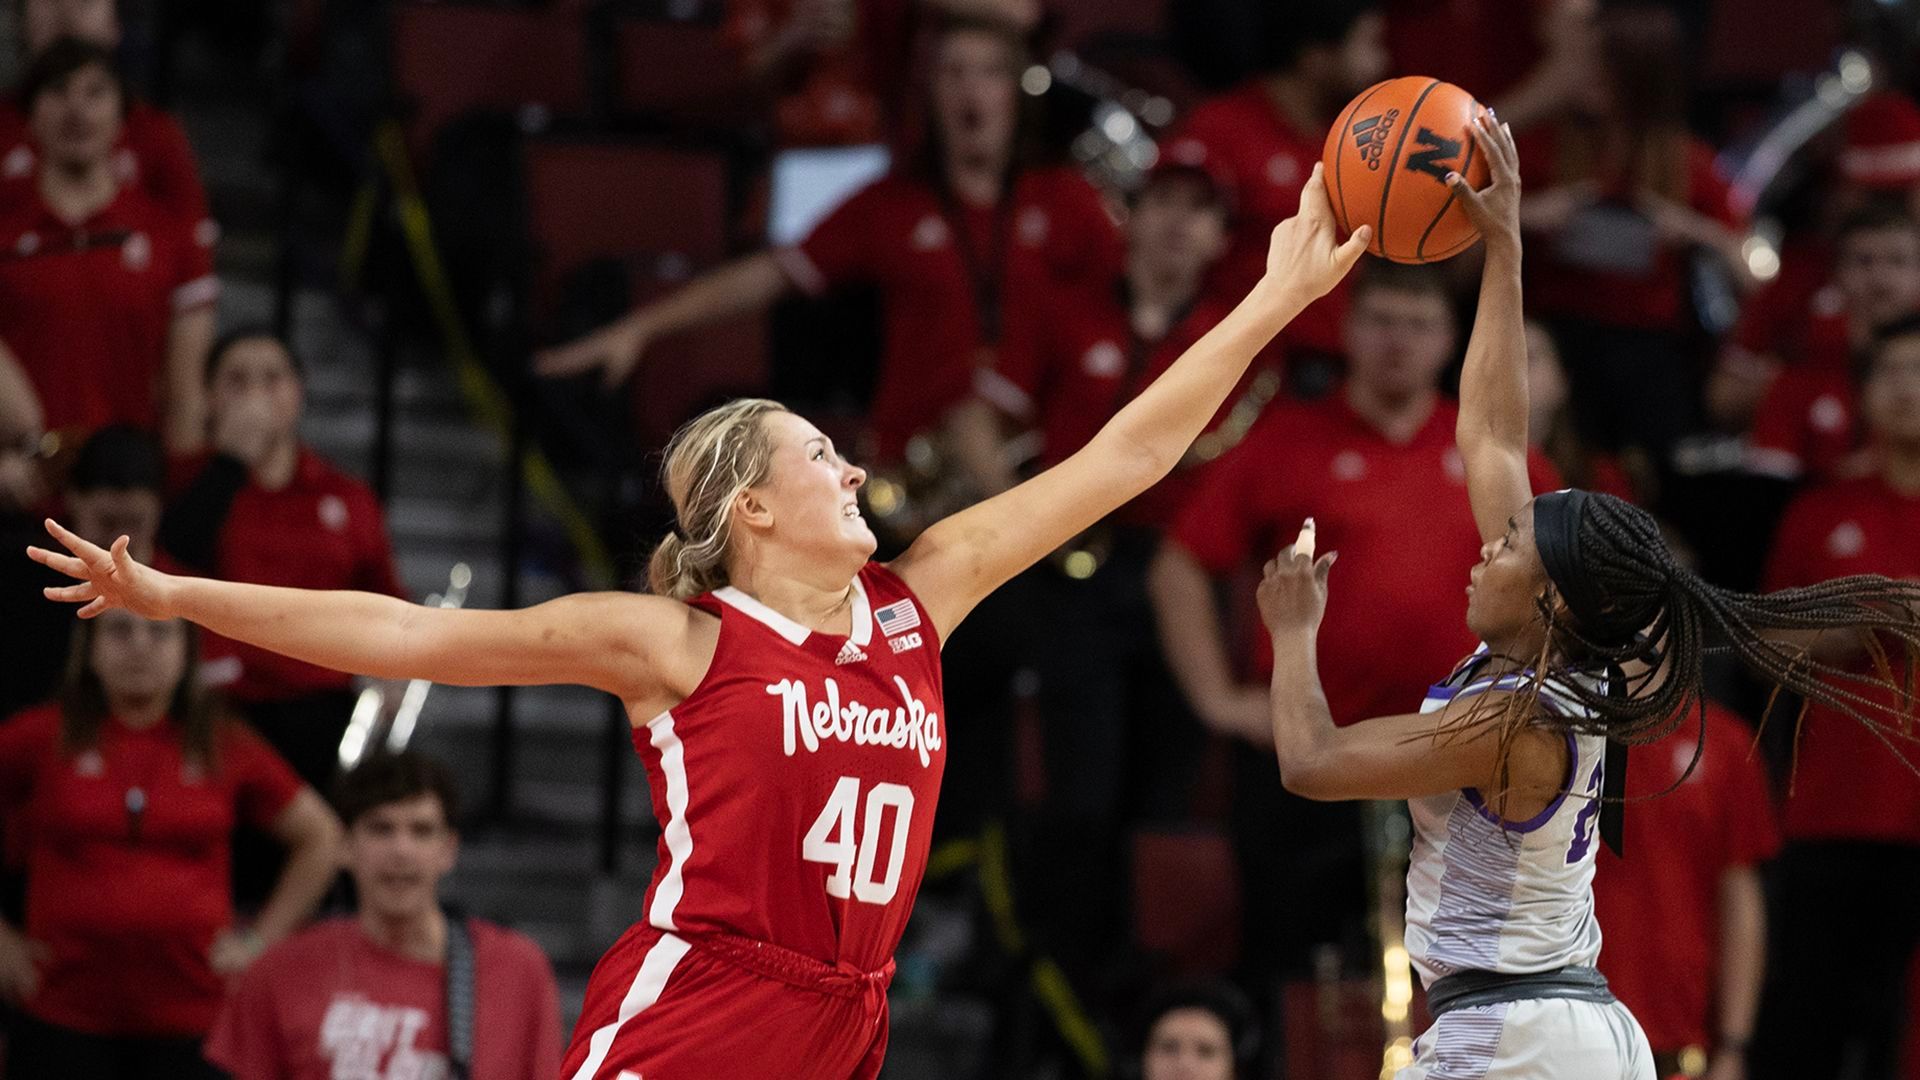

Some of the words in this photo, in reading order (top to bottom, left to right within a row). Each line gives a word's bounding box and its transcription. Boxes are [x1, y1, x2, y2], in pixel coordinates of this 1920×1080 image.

[1367, 108, 1400, 171] adidas
[1405, 126, 1463, 186] N
[766, 674, 942, 768] Nebraska
[802, 776, 915, 905] 40
